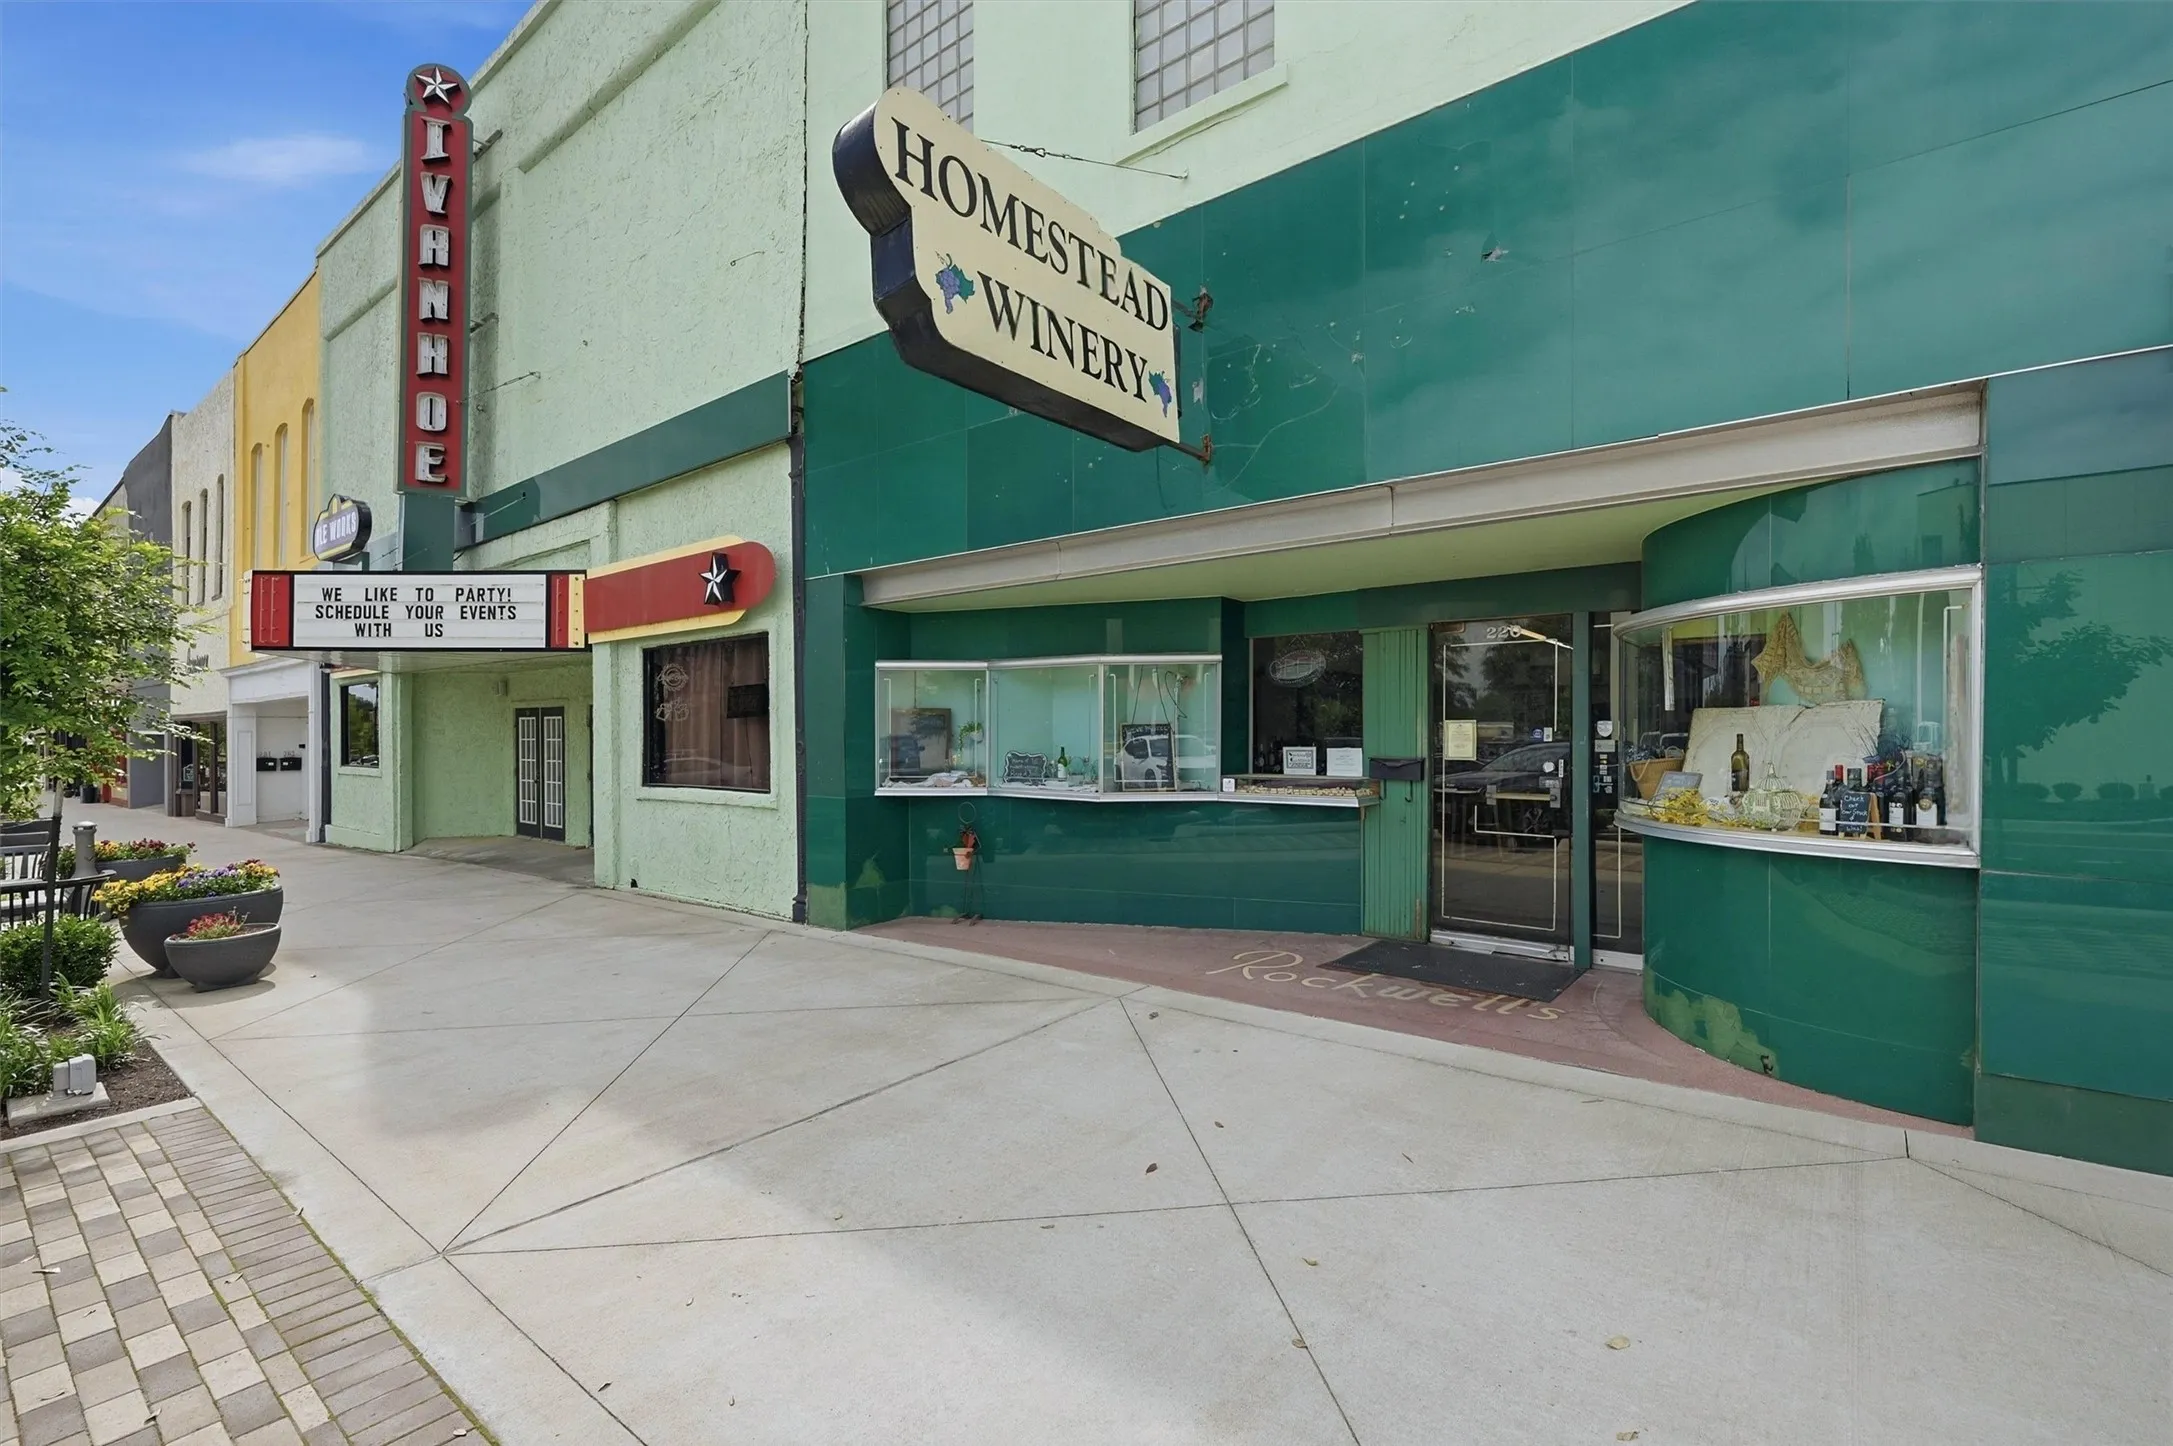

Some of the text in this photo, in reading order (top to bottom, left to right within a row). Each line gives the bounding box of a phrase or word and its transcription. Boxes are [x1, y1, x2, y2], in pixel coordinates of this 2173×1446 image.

[890, 116, 1169, 332] HOMESTEAD
[415, 116, 451, 483] IVANHOE
[976, 270, 1148, 403] WINERY
[329, 511, 357, 541] WORKS
[321, 587, 512, 602] WE LIKE TO PARTY!
[315, 605, 517, 620] SCHEDULE YOUR EVENTS
[354, 623, 443, 637] WITH US
